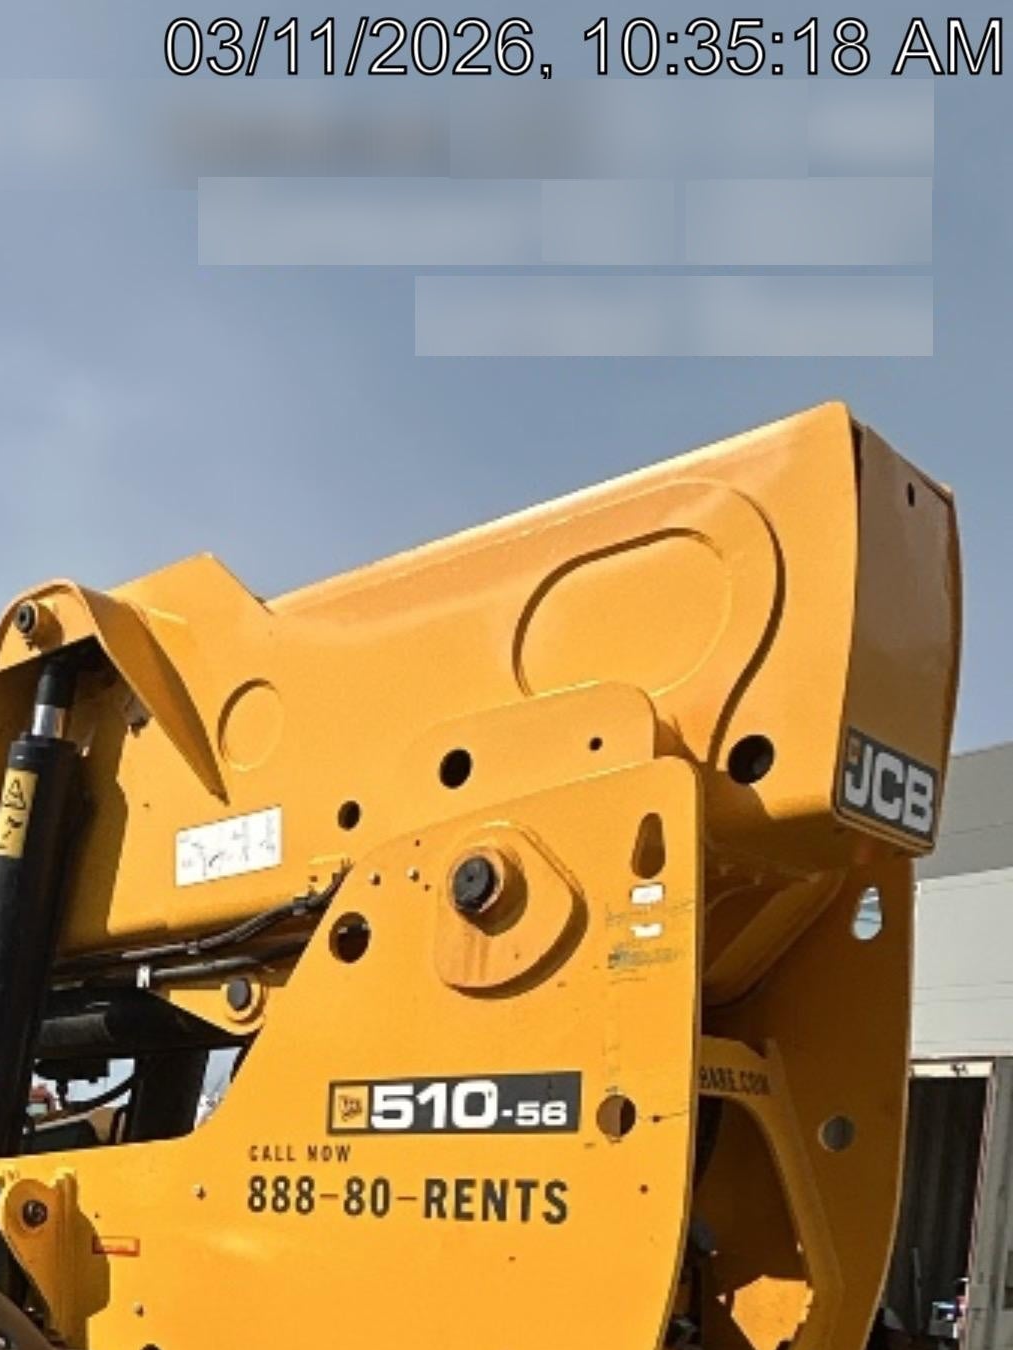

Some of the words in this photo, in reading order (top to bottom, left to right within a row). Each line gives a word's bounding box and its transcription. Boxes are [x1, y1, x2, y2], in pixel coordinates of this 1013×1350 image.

[844, 743, 934, 833] JCB
[369, 1079, 568, 1131] 510-56
[248, 1145, 297, 1162] CALL
[307, 1145, 352, 1163] NOW
[247, 1175, 569, 1225] 888-80-RENTS
